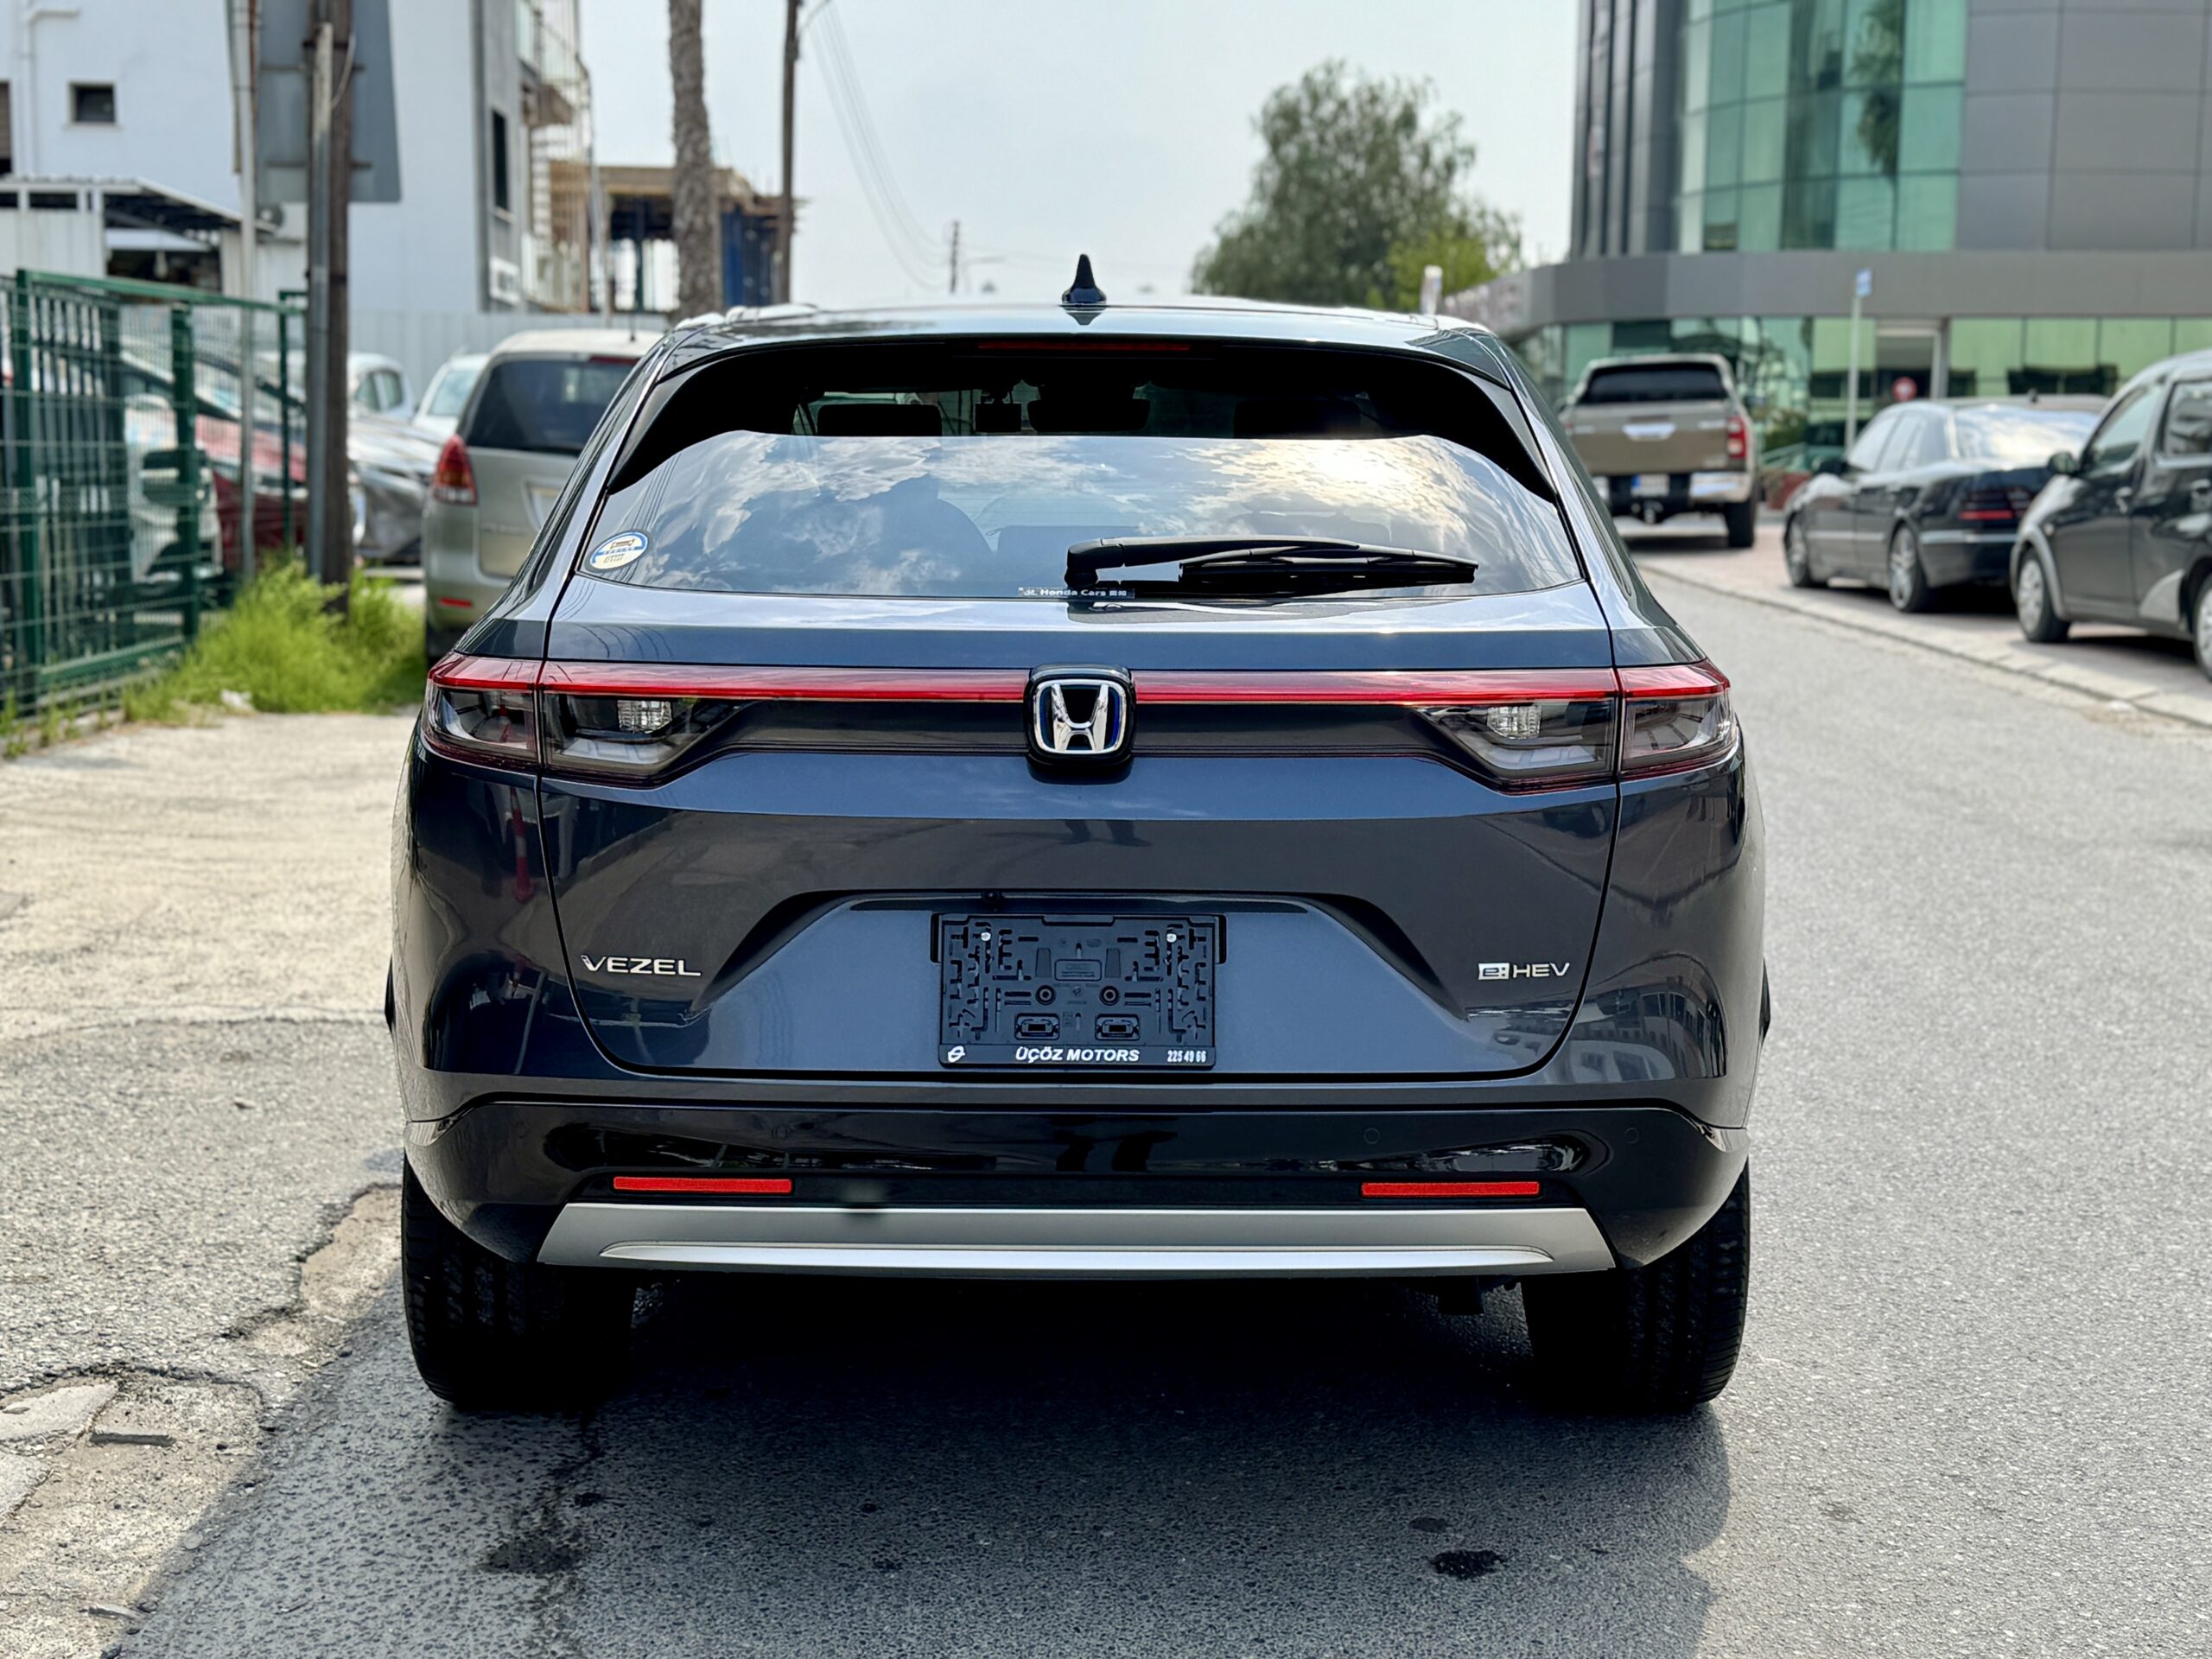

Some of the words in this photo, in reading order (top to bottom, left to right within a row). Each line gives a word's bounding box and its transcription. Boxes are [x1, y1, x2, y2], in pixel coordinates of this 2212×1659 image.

[1039, 588, 1078, 597] Honda
[1080, 588, 1107, 597] Cars
[580, 954, 702, 976] VEZEL
[1015, 1046, 1064, 1064] ÜÇÖZ
[1066, 1048, 1141, 1062] MOTORS
